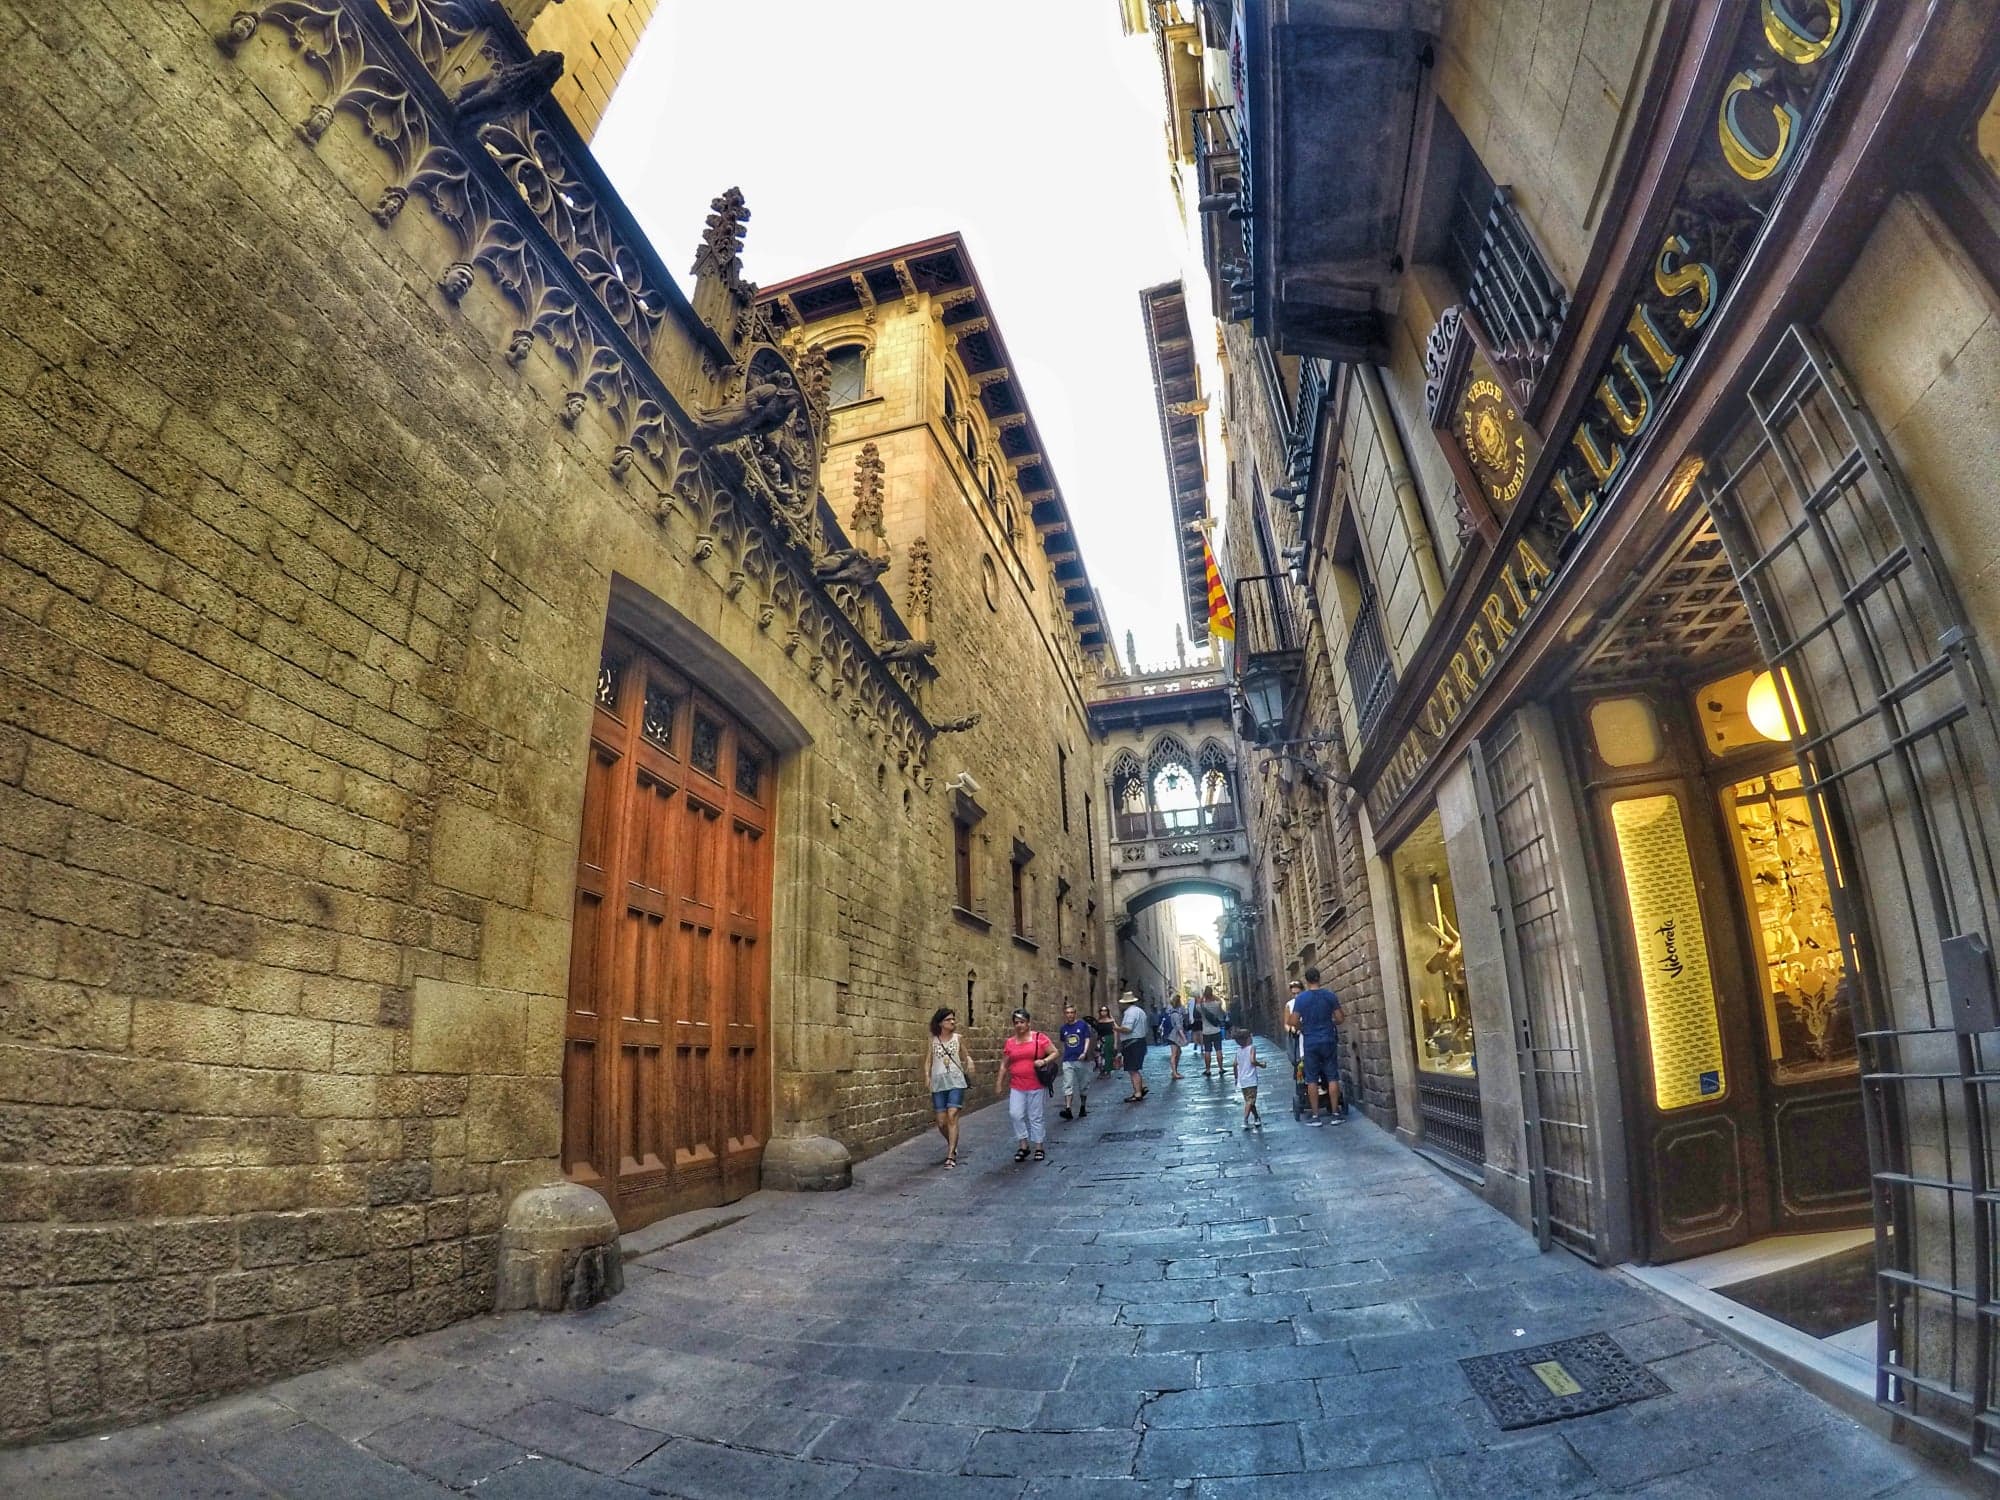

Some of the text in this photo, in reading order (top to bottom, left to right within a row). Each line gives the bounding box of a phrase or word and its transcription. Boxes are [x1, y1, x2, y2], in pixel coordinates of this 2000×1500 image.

[1464, 380, 1503, 464] CERA VERGE
[1492, 434, 1525, 501] D'ABELLA
[1370, 728, 1427, 820] ANTIGA
[1427, 539, 1553, 738] CERERIA
[1552, 234, 1717, 535] LLUIS
